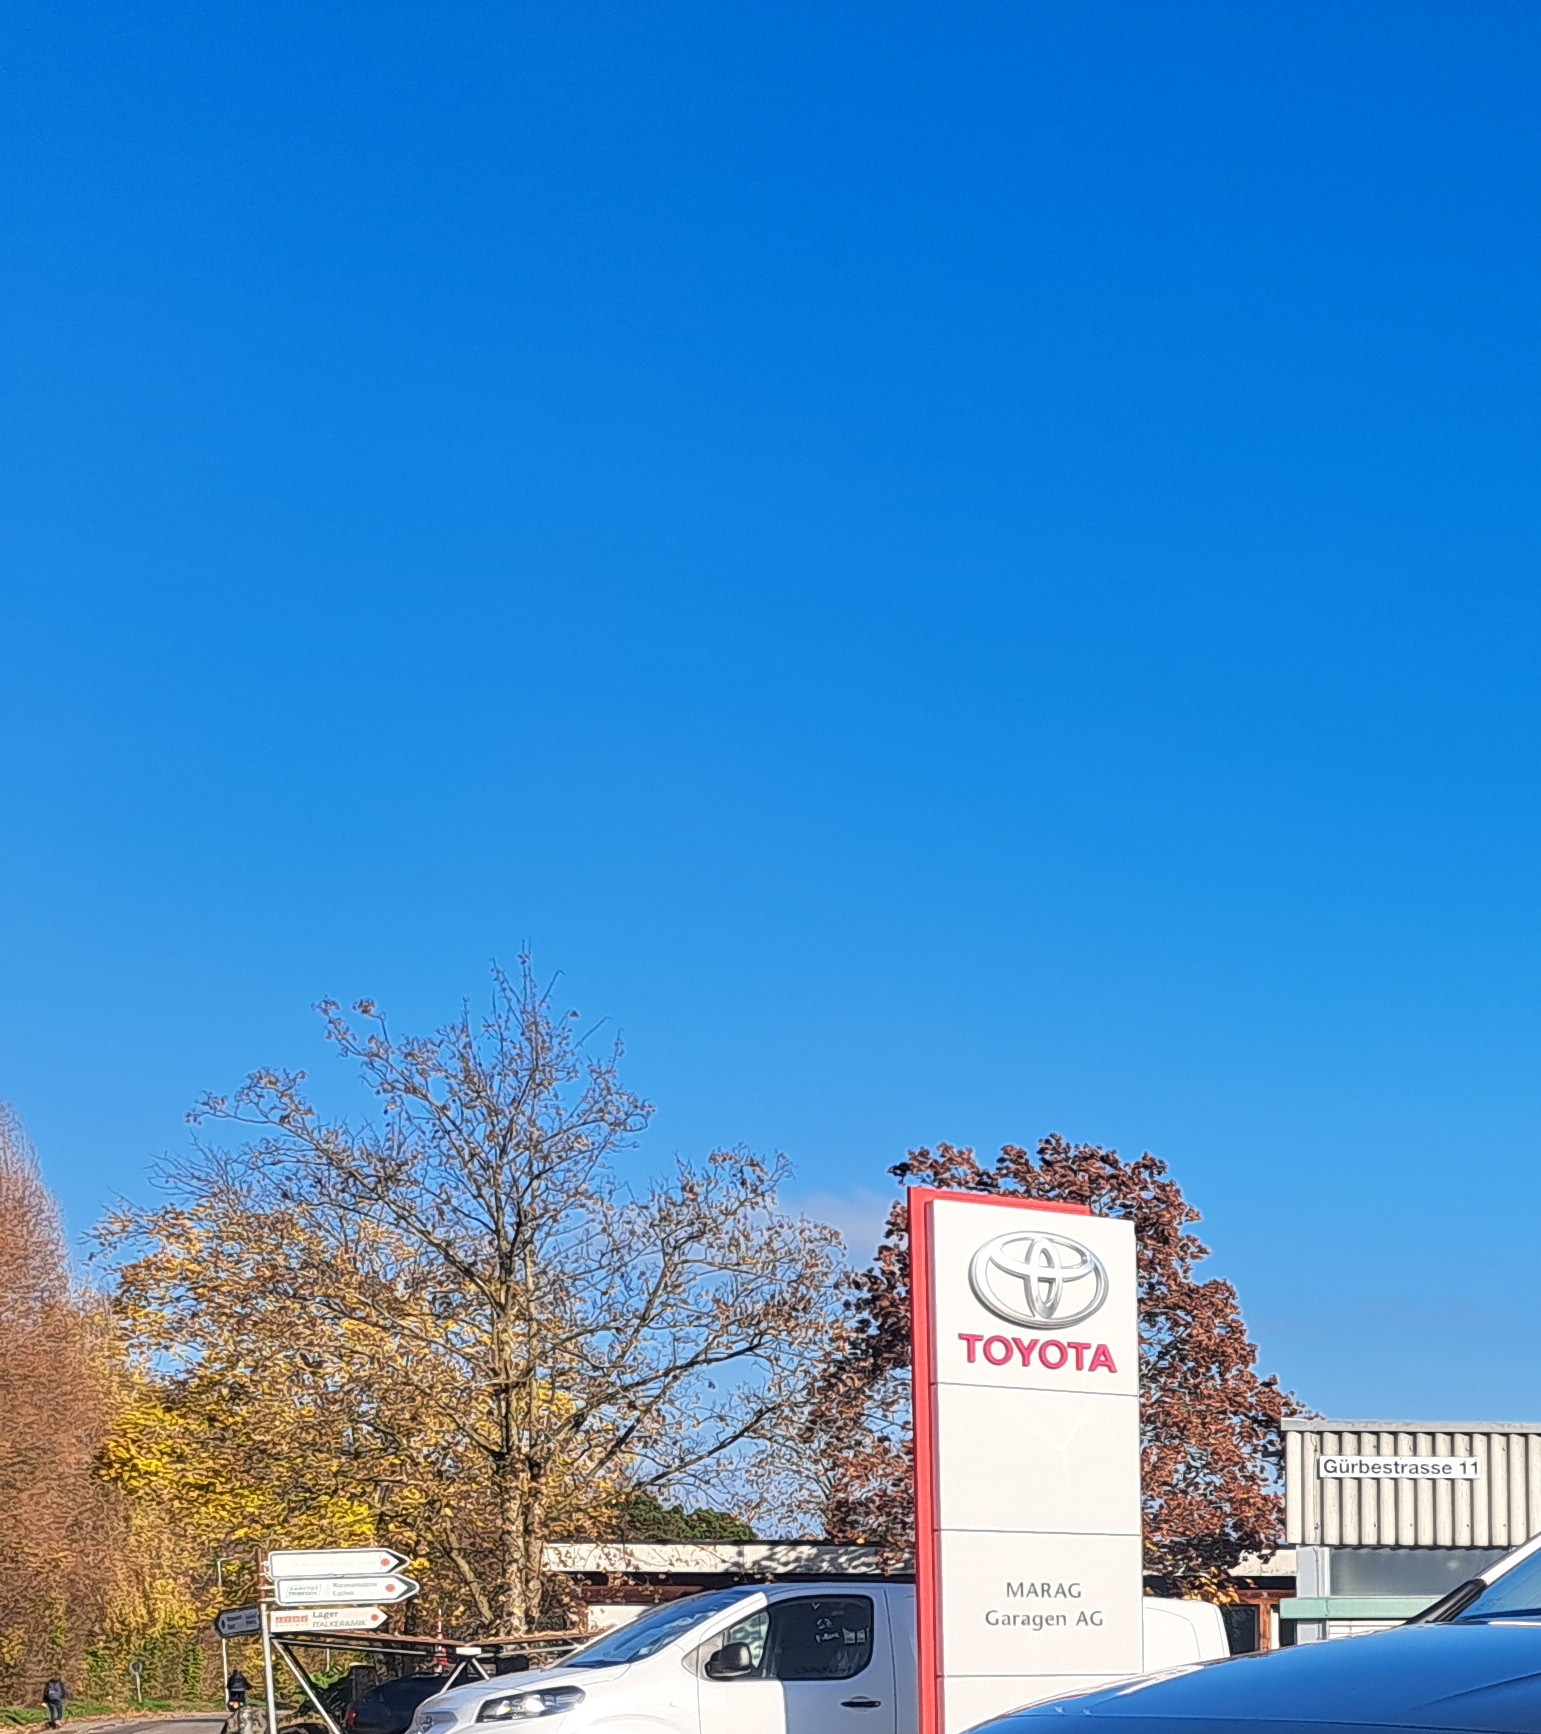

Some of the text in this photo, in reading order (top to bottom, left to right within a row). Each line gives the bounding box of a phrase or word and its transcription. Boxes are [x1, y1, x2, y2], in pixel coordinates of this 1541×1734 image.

[958, 1333, 1118, 1374] TOYOTA
[1323, 1458, 1479, 1476] Gürbestrasse 11
[1005, 1581, 1082, 1599] MARAG
[312, 1611, 339, 1619] Lager
[985, 1609, 1104, 1631] Garagen AG
